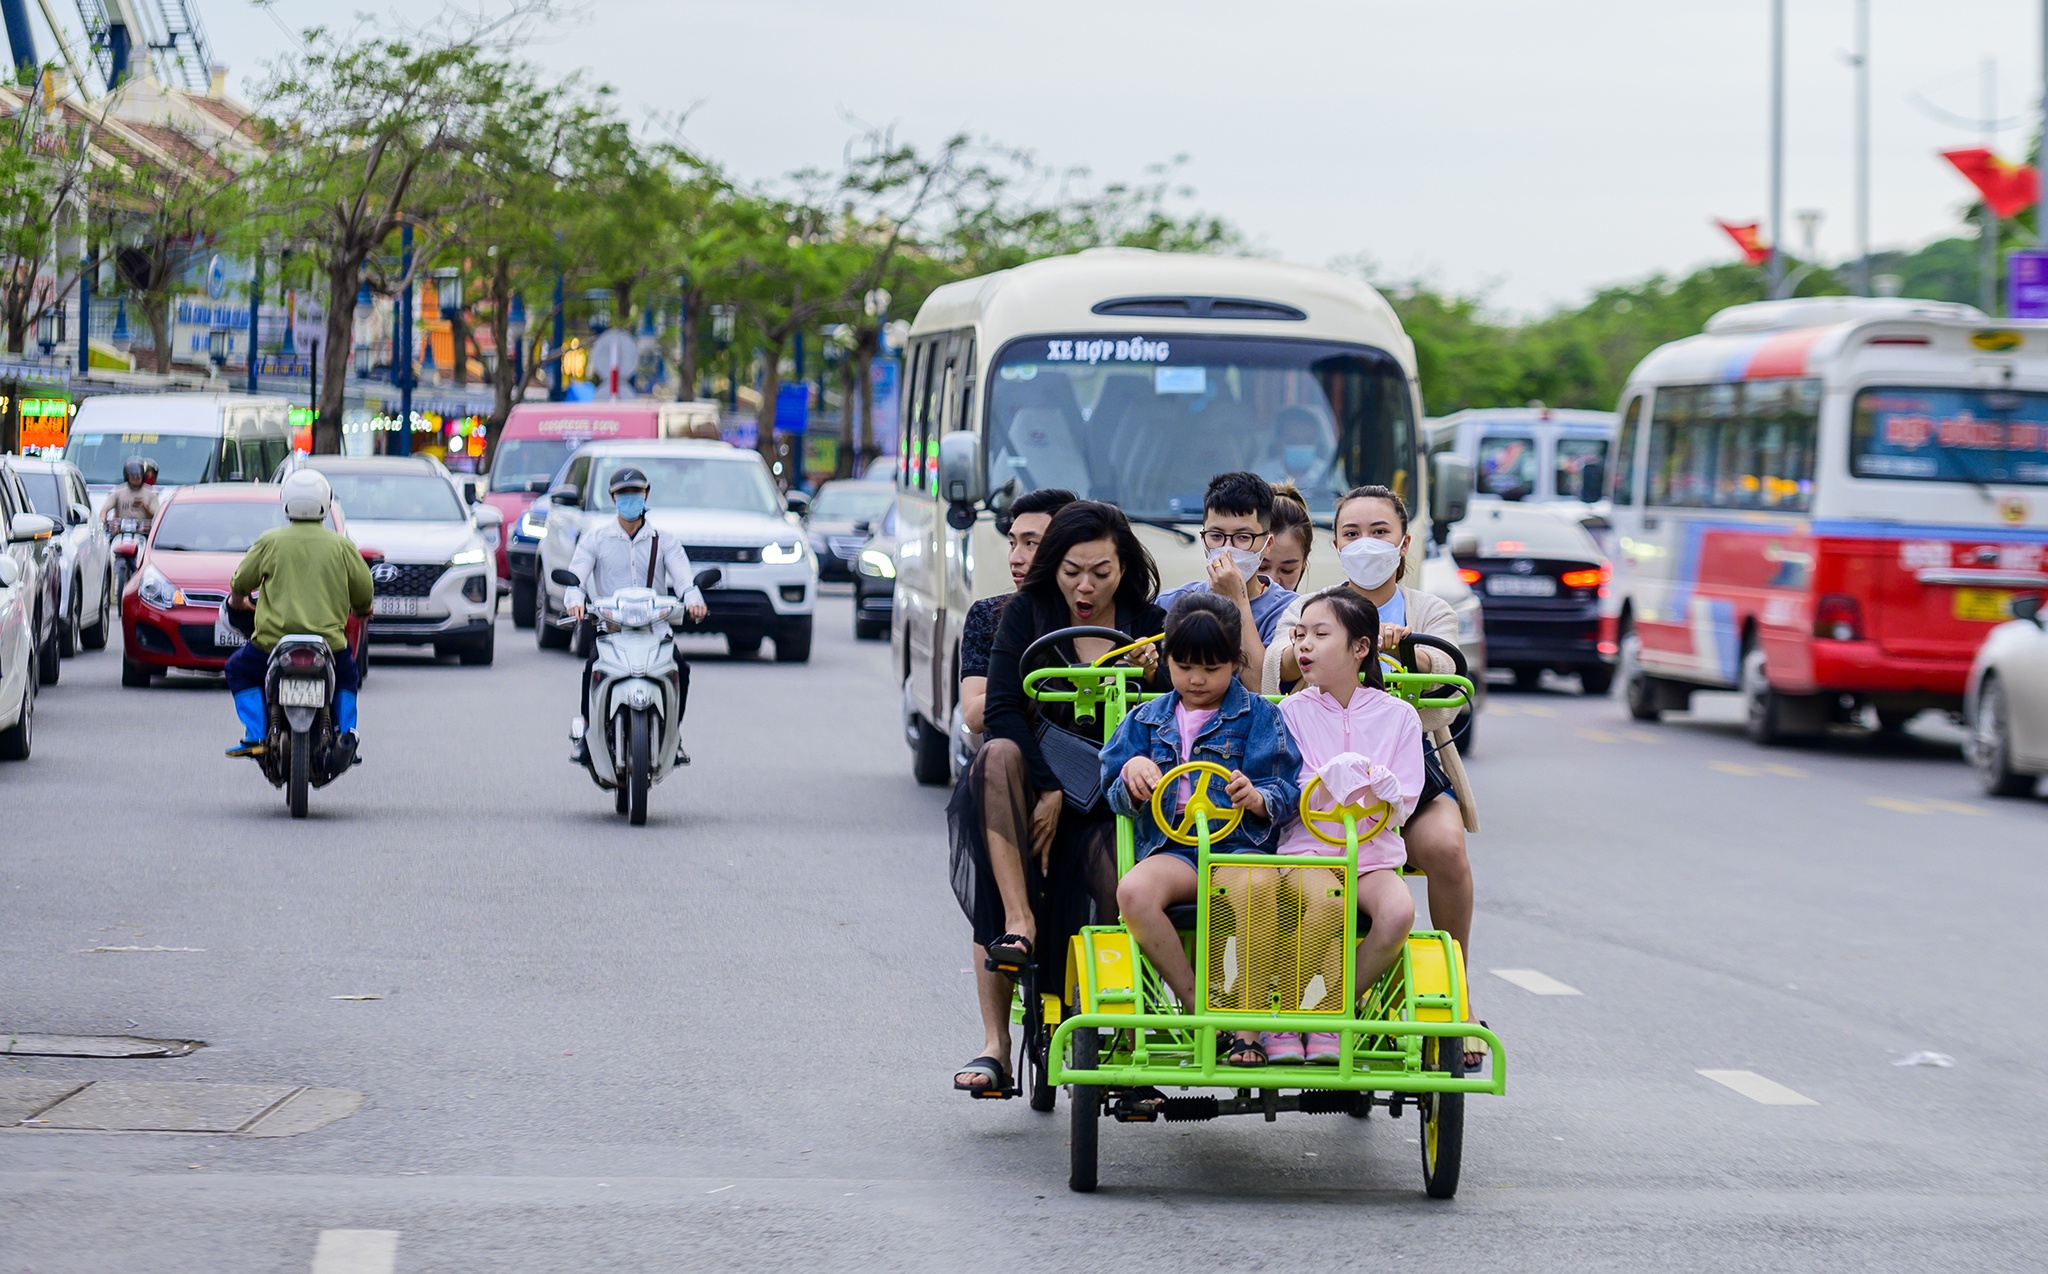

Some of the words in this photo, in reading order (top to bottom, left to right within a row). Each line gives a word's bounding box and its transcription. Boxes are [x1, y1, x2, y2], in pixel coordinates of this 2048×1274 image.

[1047, 340, 1073, 361] XE
[1075, 338, 1115, 365] HỢP
[1115, 336, 1170, 362] ĐỒNG
